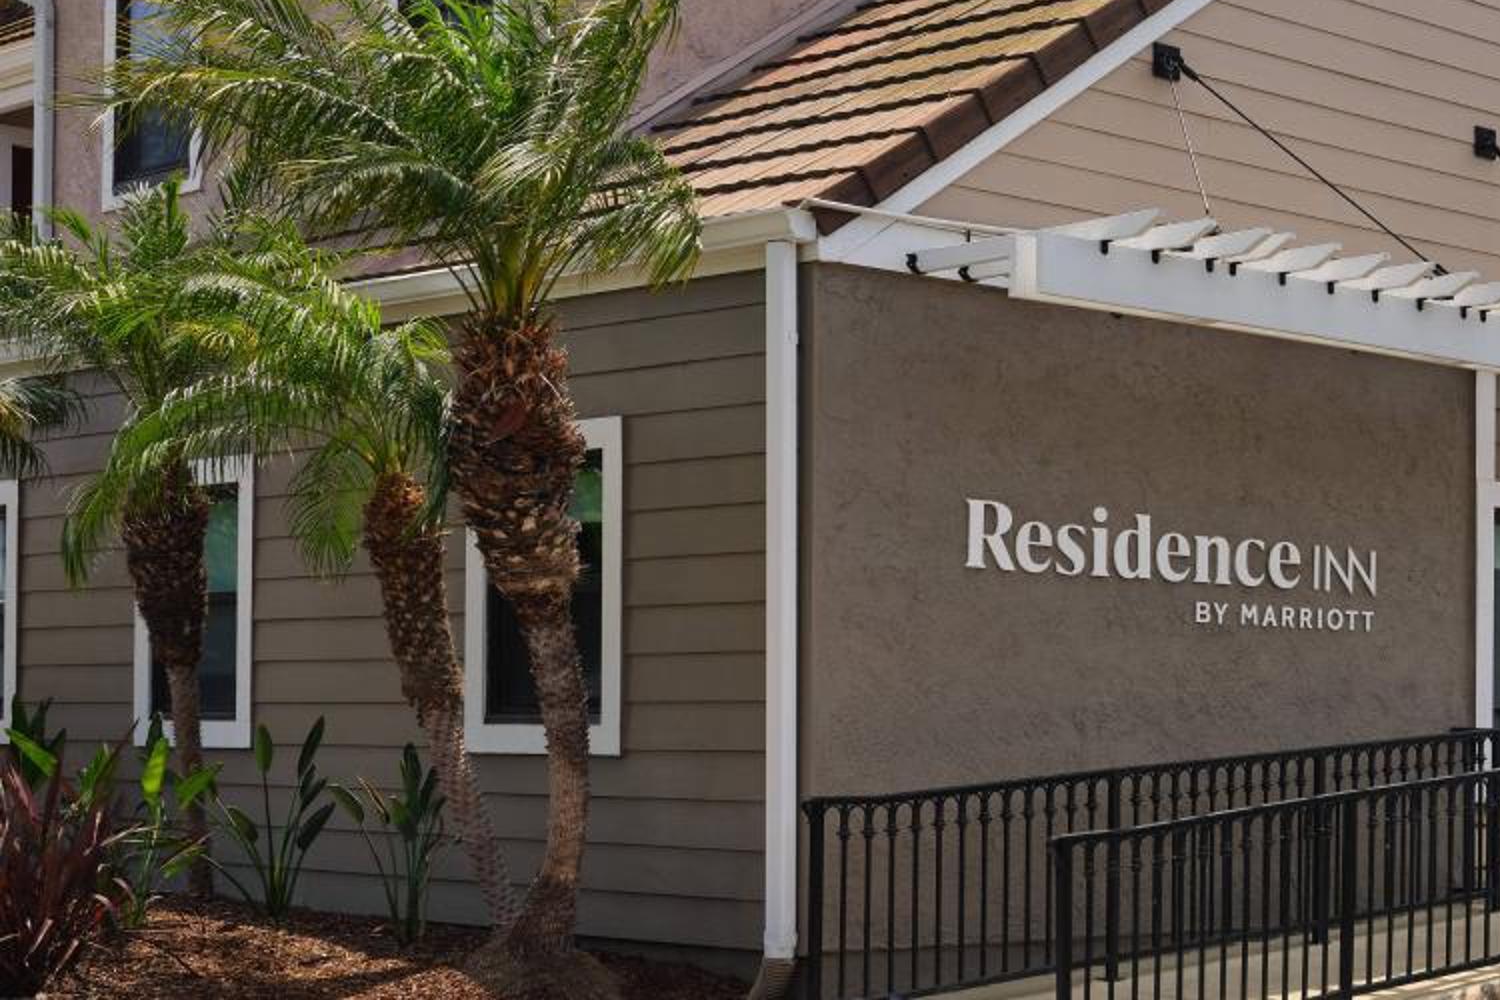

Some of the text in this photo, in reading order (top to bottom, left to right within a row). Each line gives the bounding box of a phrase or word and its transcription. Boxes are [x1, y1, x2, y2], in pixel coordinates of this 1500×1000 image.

[965, 498, 1378, 597] Residence INN
[1195, 601, 1375, 632] BY MARRIOTT
